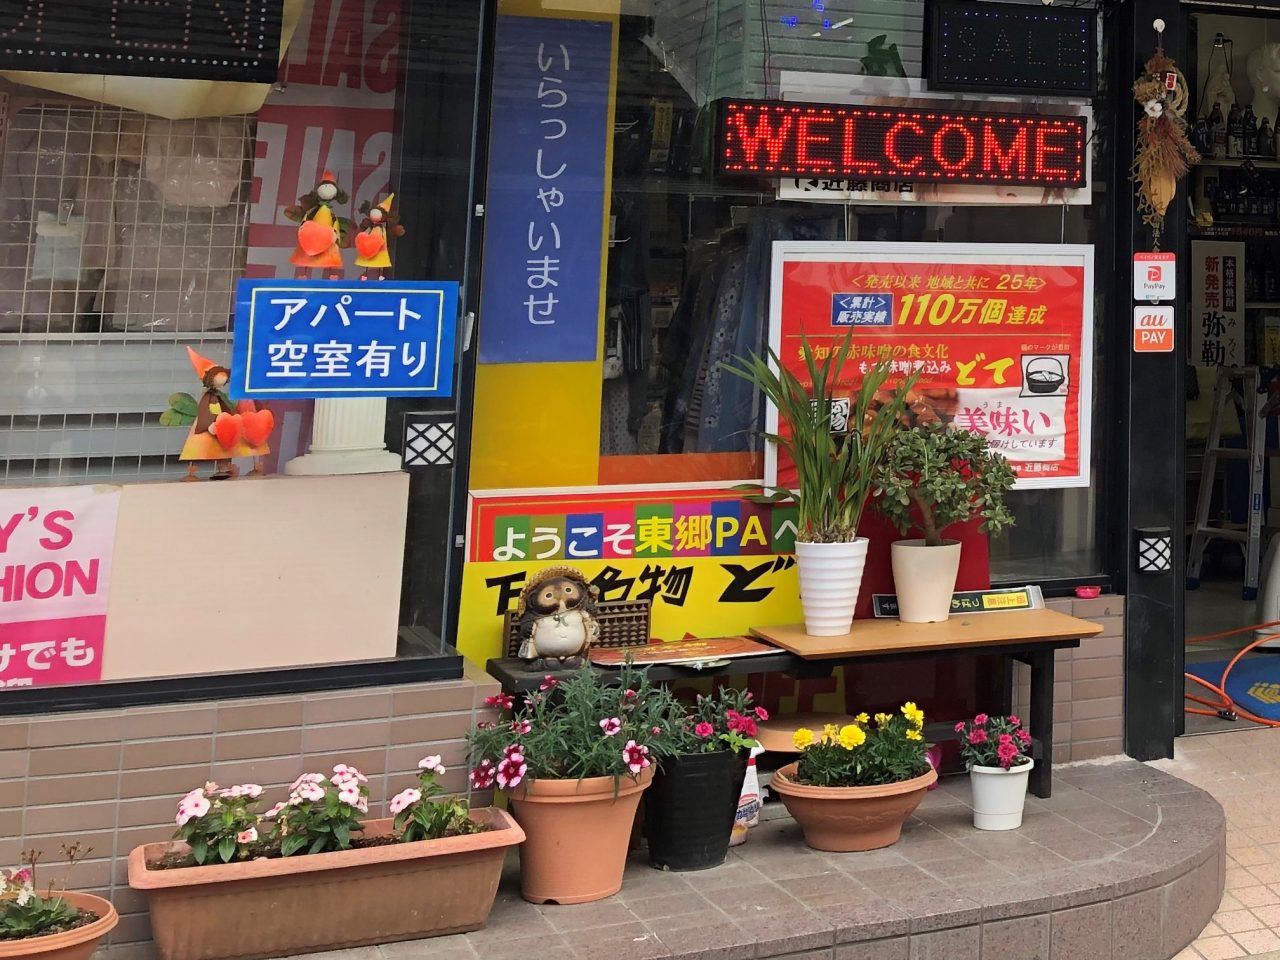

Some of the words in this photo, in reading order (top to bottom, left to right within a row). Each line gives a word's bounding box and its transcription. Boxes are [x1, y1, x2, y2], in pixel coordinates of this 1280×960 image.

[958, 26, 1078, 68] SALE
[734, 108, 1065, 174] WELCOME
[522, 42, 570, 327] いらっしゃいませ
[1143, 282, 1165, 291] PayPay
[1205, 256, 1219, 308] 新発売
[270, 295, 422, 332] アパート
[837, 310, 888, 324] 販売実績
[1140, 314, 1168, 327] au
[1141, 331, 1166, 344] PAY
[1201, 310, 1226, 367] 弥勒
[265, 339, 428, 379] 空室有り
[955, 352, 1015, 386] どて
[955, 406, 1051, 437] 美味い
[984, 437, 1058, 451] 届けしています
[492, 514, 799, 561] ようこそ東郷PAへ
[486, 563, 694, 617] 下名物
